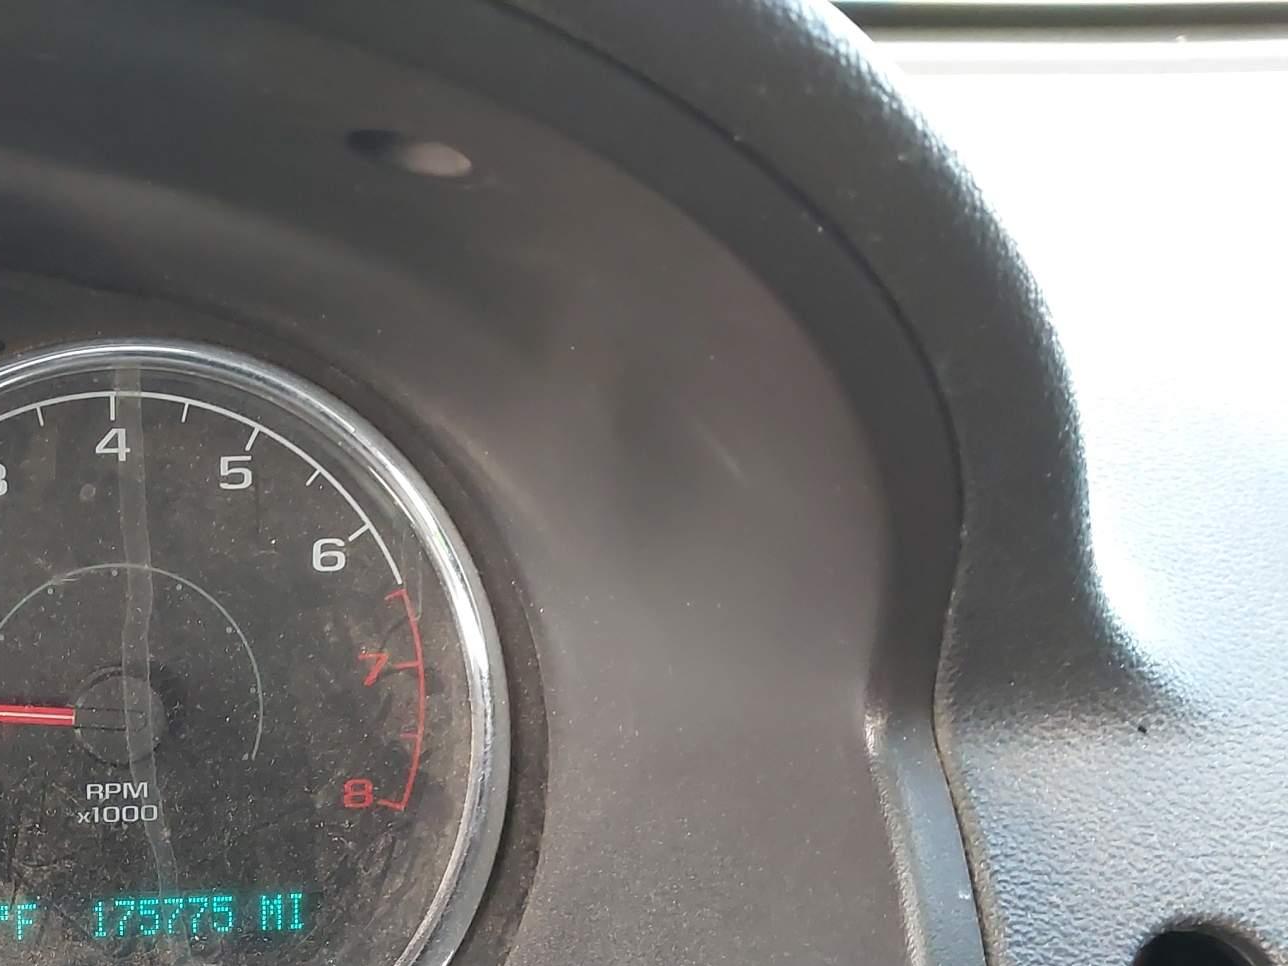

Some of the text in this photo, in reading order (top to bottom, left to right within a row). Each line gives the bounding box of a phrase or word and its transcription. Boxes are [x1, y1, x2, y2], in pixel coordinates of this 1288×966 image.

[95, 428, 130, 461] 4
[219, 455, 253, 490] 5
[312, 538, 347, 572] 6
[358, 652, 389, 686] 7
[86, 782, 149, 801] RPM
[343, 778, 374, 808] 8
[78, 804, 158, 824] x1000
[93, 895, 234, 938] 175775
[261, 893, 304, 931] MI
